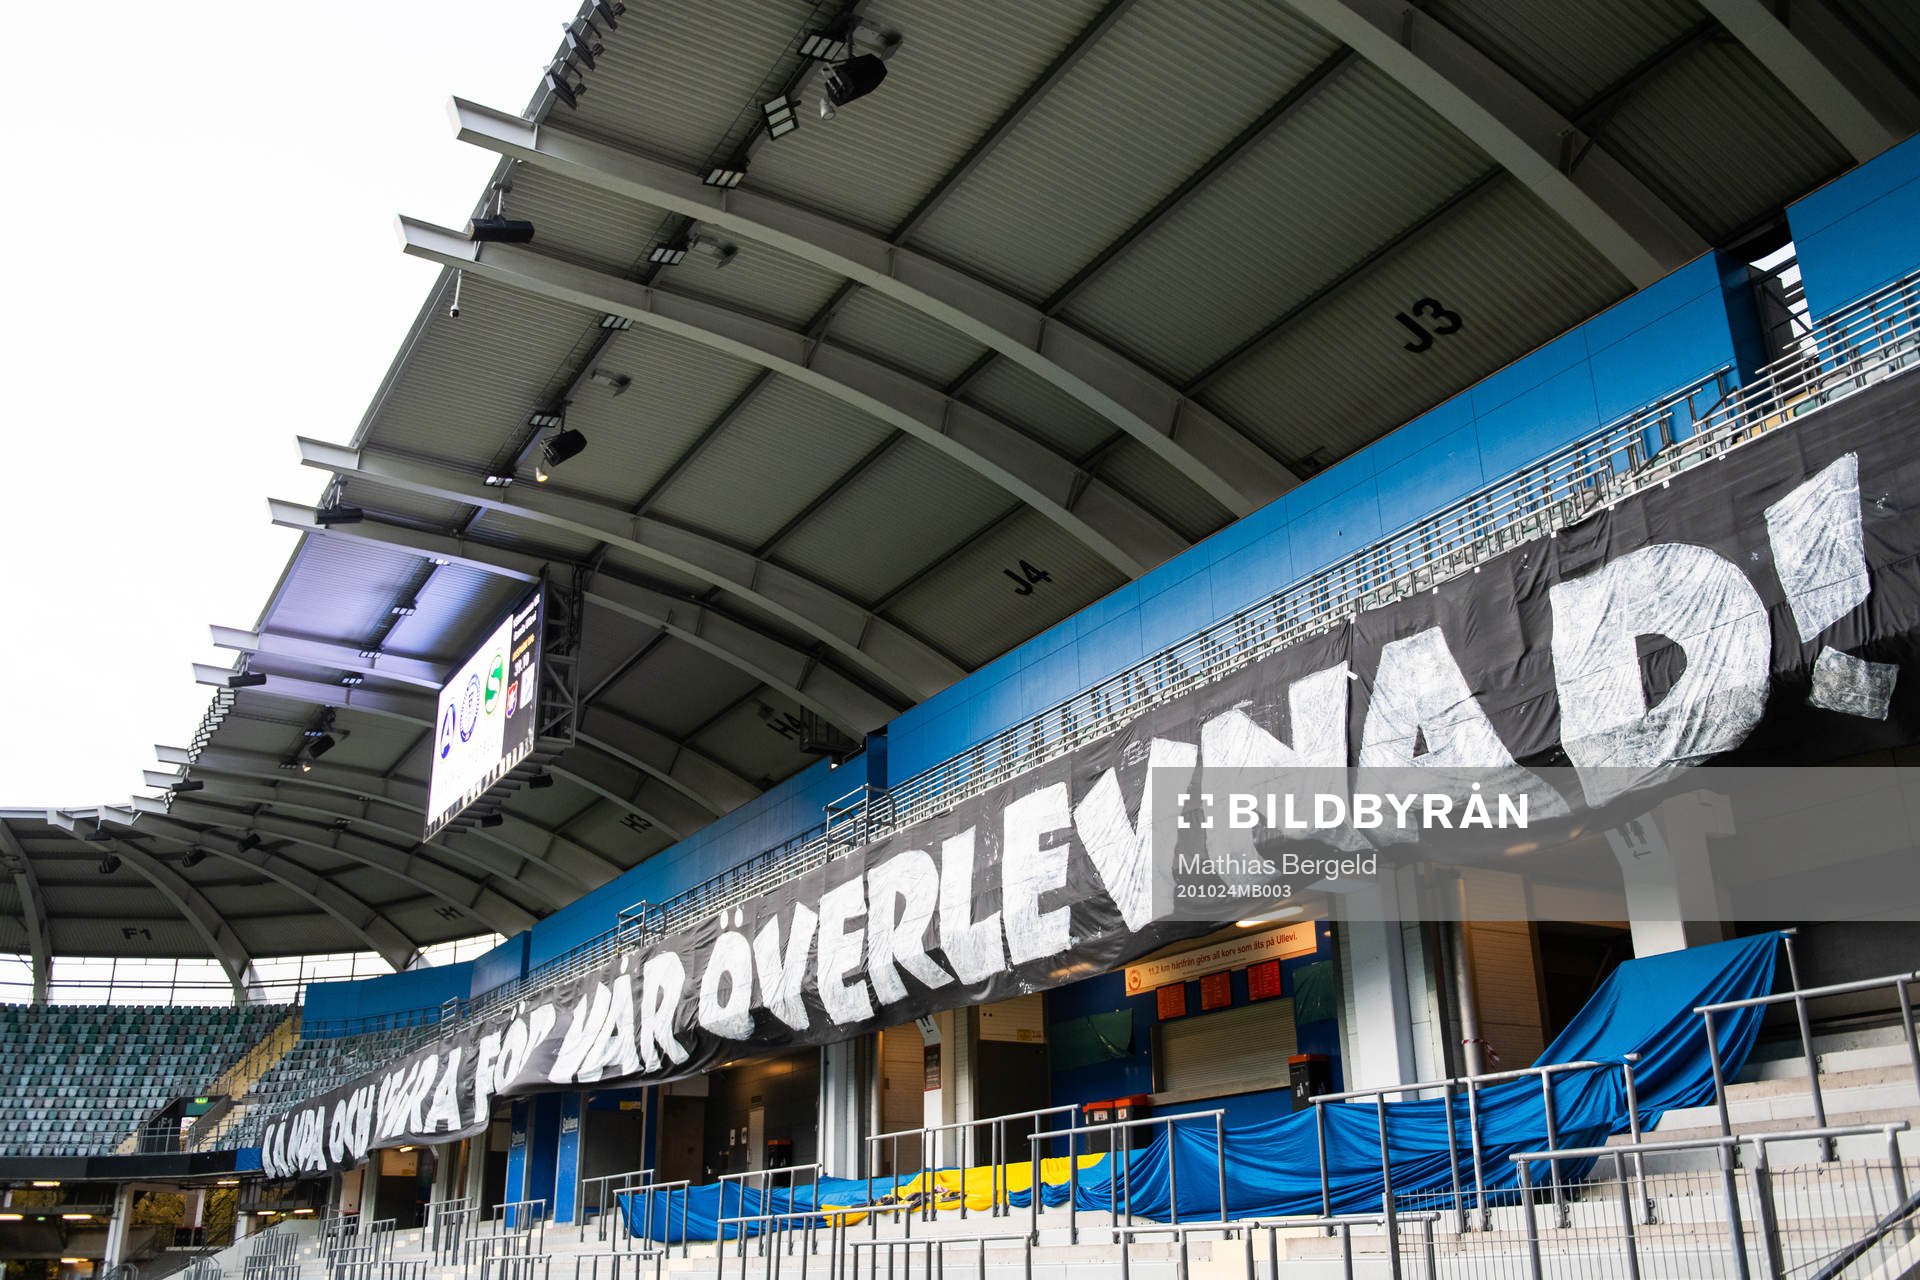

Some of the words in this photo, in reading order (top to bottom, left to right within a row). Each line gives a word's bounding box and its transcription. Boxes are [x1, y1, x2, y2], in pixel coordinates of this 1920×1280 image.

[1395, 298, 1462, 353] J3
[1003, 560, 1052, 595] J4
[619, 813, 652, 833] H3
[121, 927, 152, 941] F1
[329, 1084, 376, 1164] OCH
[548, 951, 690, 1084] VÅR
